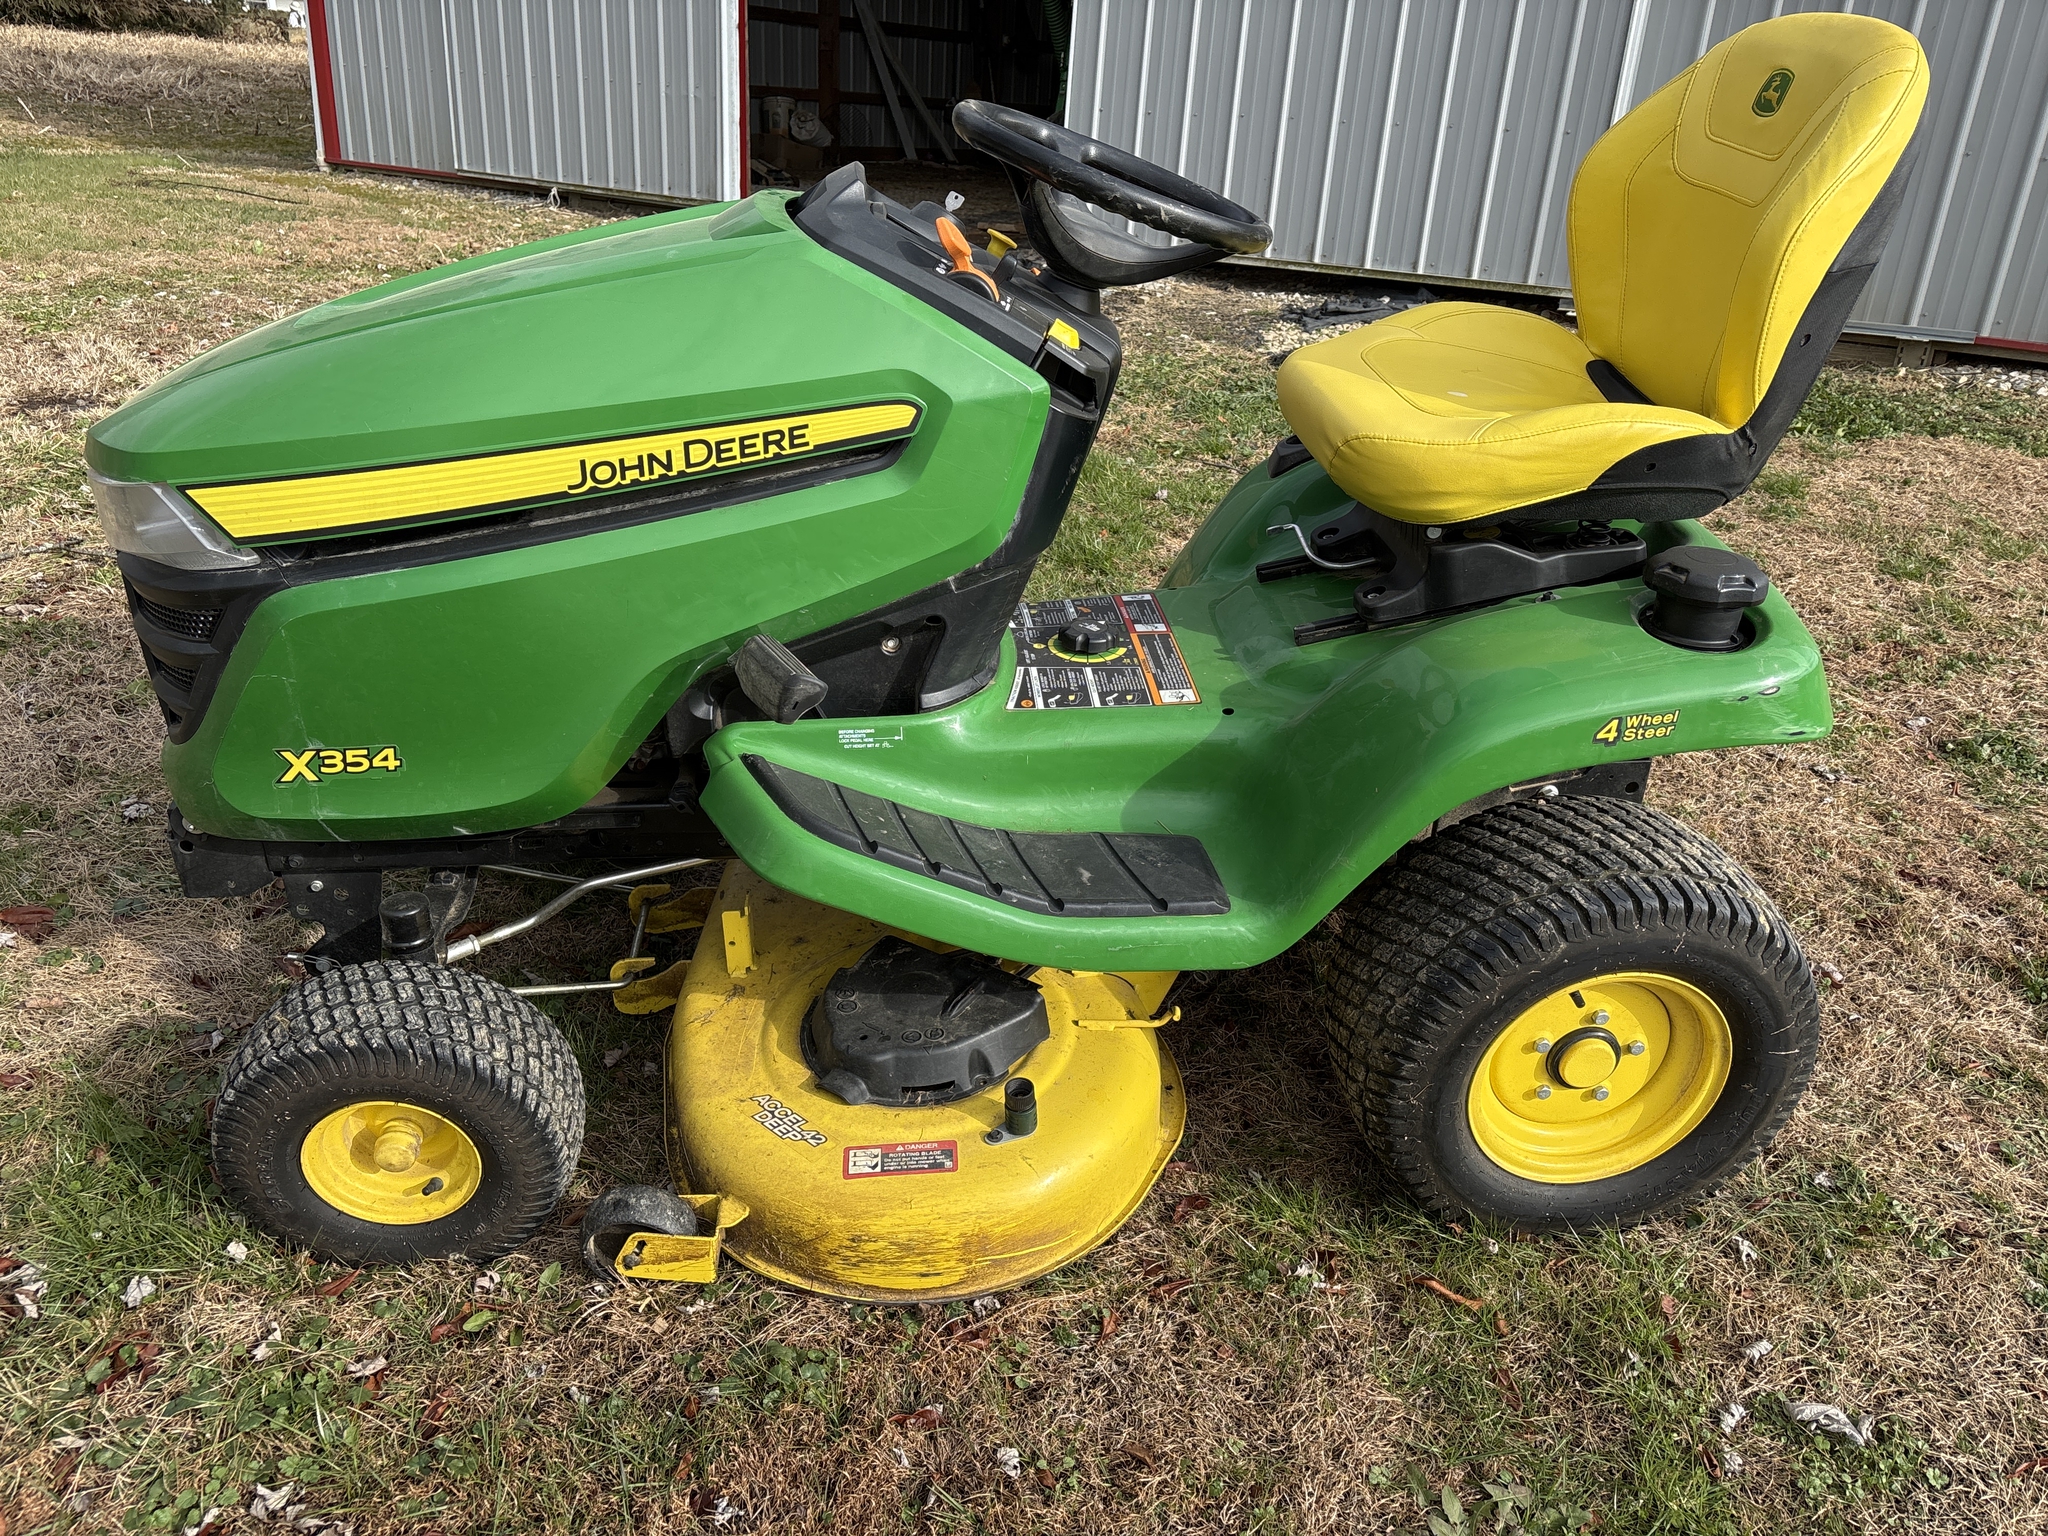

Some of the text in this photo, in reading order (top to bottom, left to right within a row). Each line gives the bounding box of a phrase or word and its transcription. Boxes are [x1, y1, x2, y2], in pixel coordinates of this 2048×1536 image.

[567, 424, 810, 490] JOHN DEERE
[1594, 709, 1679, 744] 4 Wheel
[1622, 725, 1675, 742] Steer
[276, 746, 402, 783] X354
[750, 1094, 828, 1147] ACCEL 42
[751, 1110, 803, 1141] DEEP
